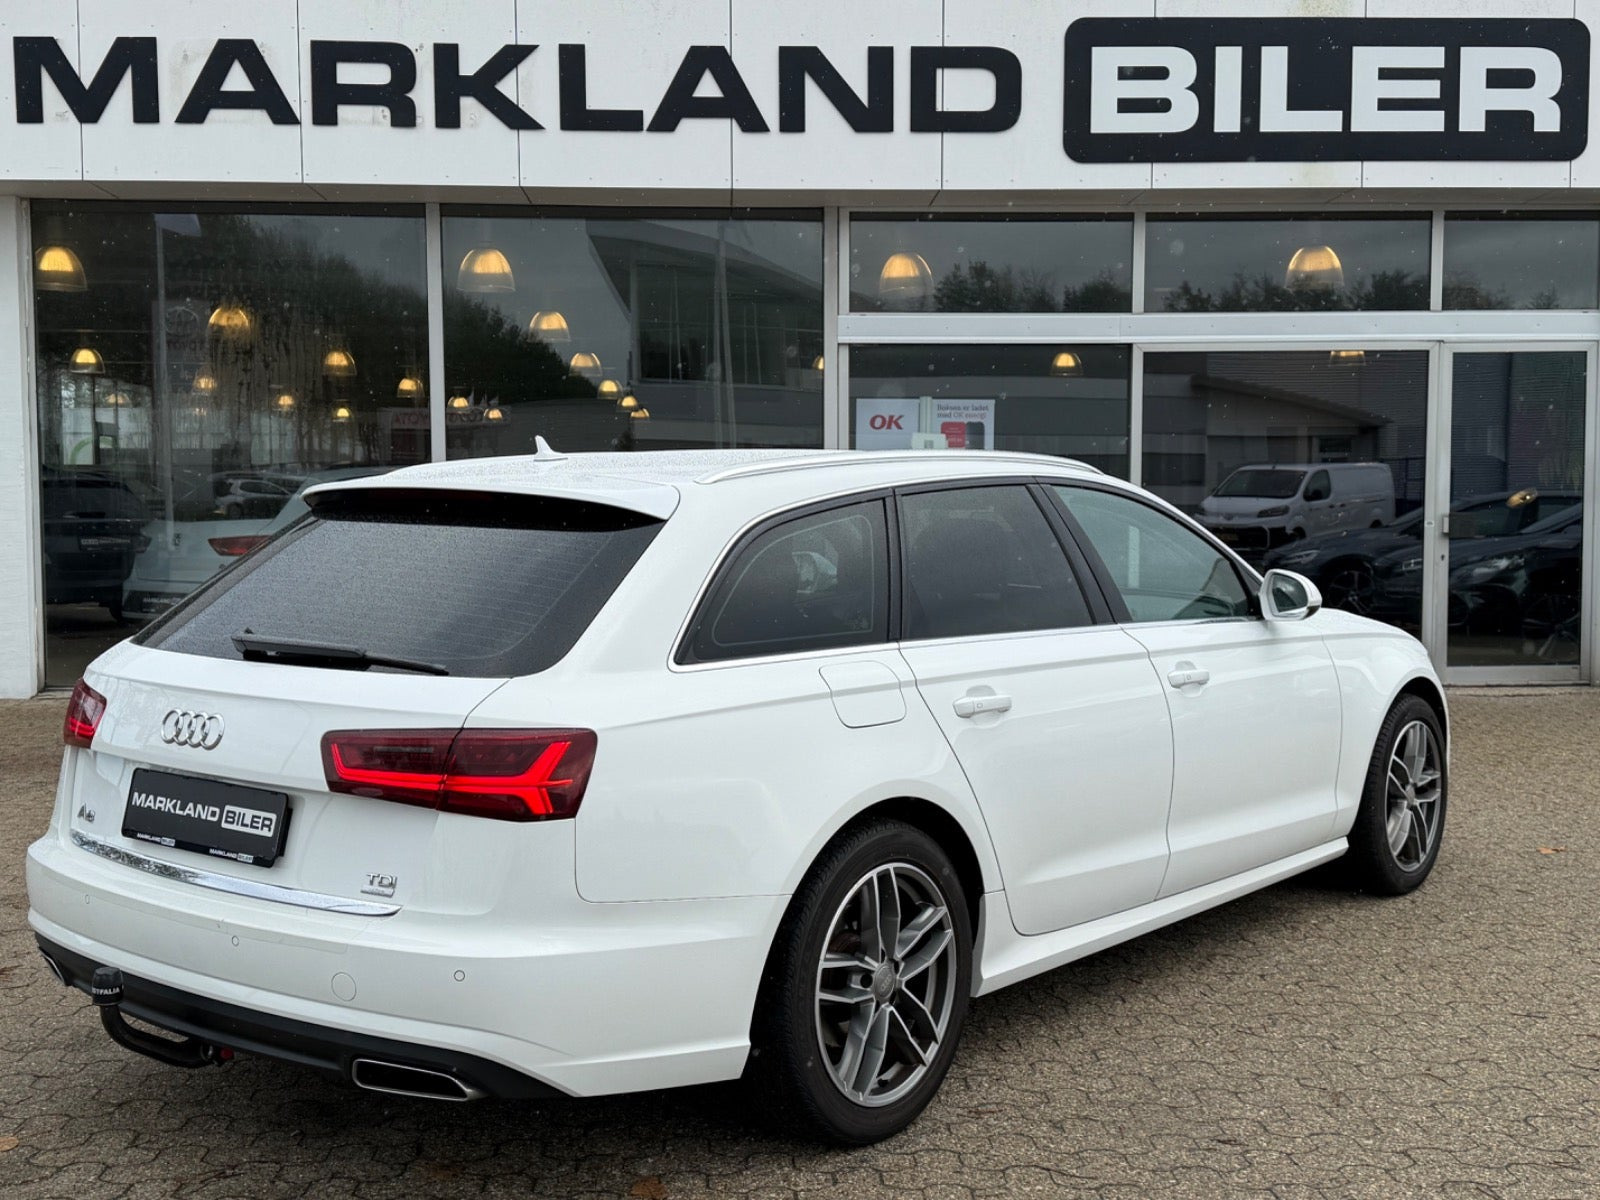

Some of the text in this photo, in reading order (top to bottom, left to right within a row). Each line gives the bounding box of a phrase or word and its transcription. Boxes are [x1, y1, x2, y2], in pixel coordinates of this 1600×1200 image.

[14, 37, 1563, 135] MARKLAND BILER
[869, 414, 905, 431] OK
[131, 791, 274, 833] MARKLAND BILER
[366, 873, 398, 889] TDI
